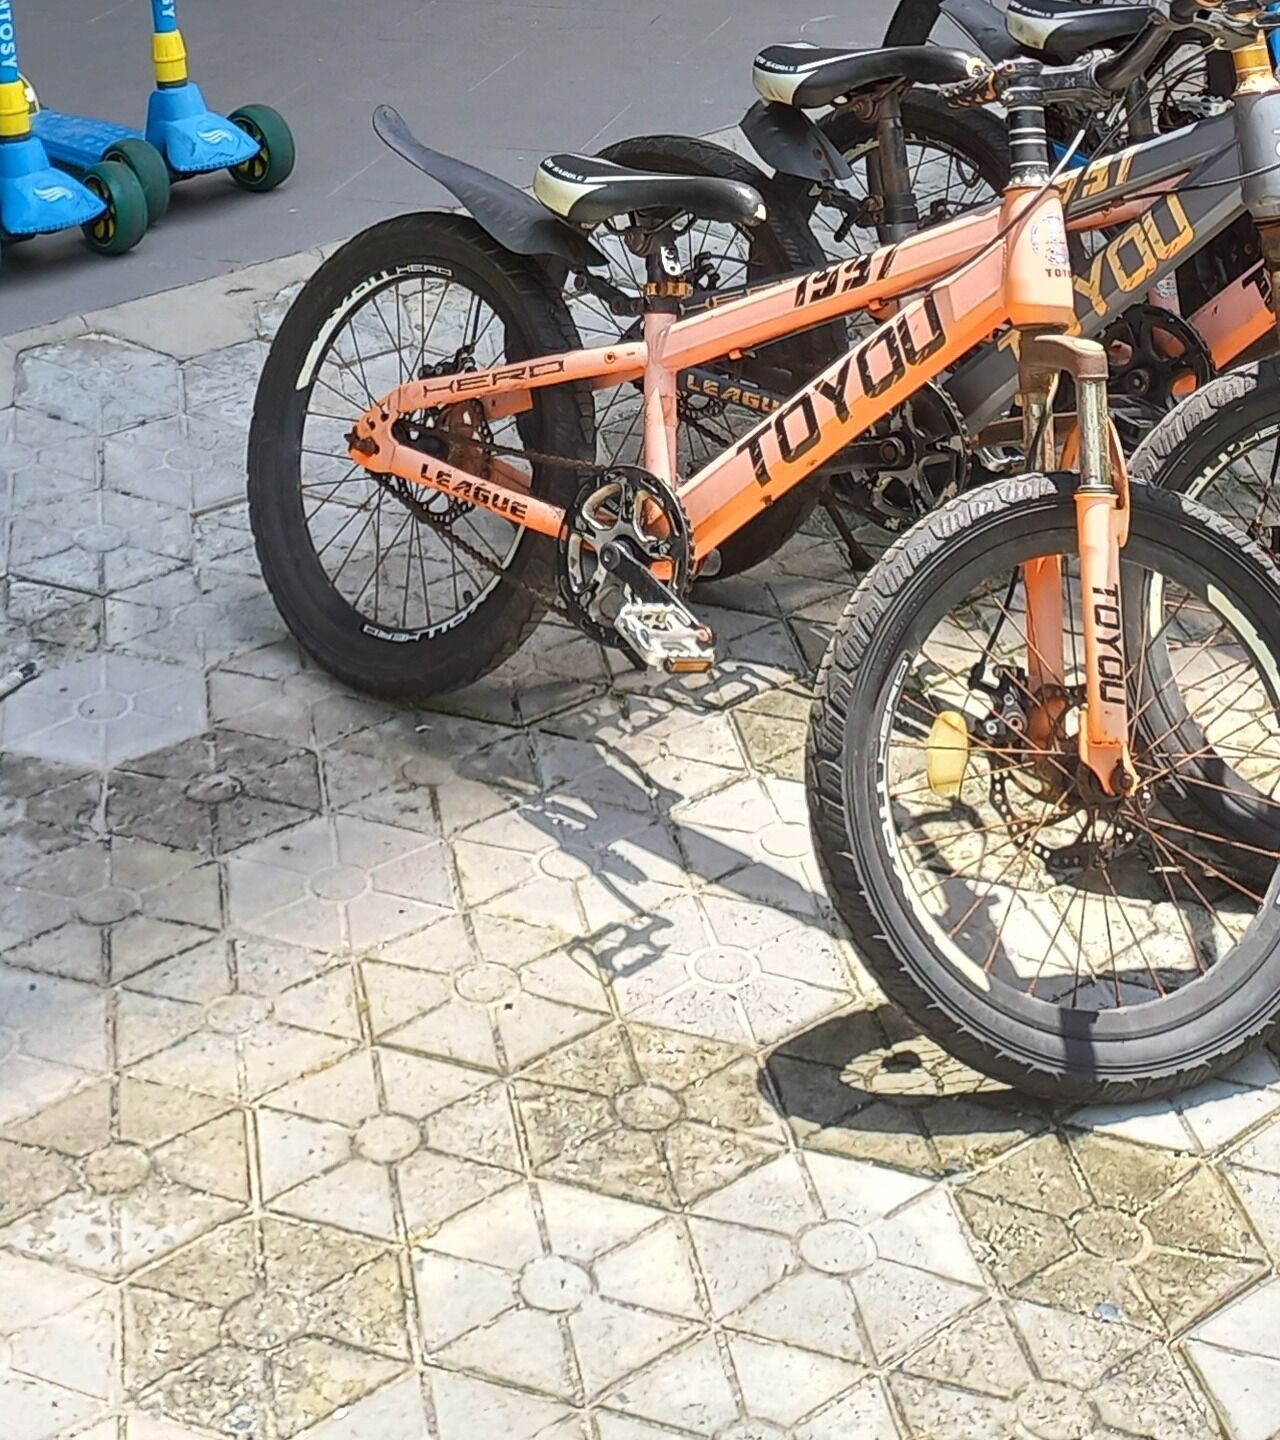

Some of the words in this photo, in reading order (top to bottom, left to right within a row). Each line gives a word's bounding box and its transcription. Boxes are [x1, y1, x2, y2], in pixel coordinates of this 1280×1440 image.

[422, 359, 566, 399] HERO
[735, 292, 947, 488] TOYOU
[419, 461, 530, 521] LEAGUE
[1092, 583, 1127, 707] TOYOU
